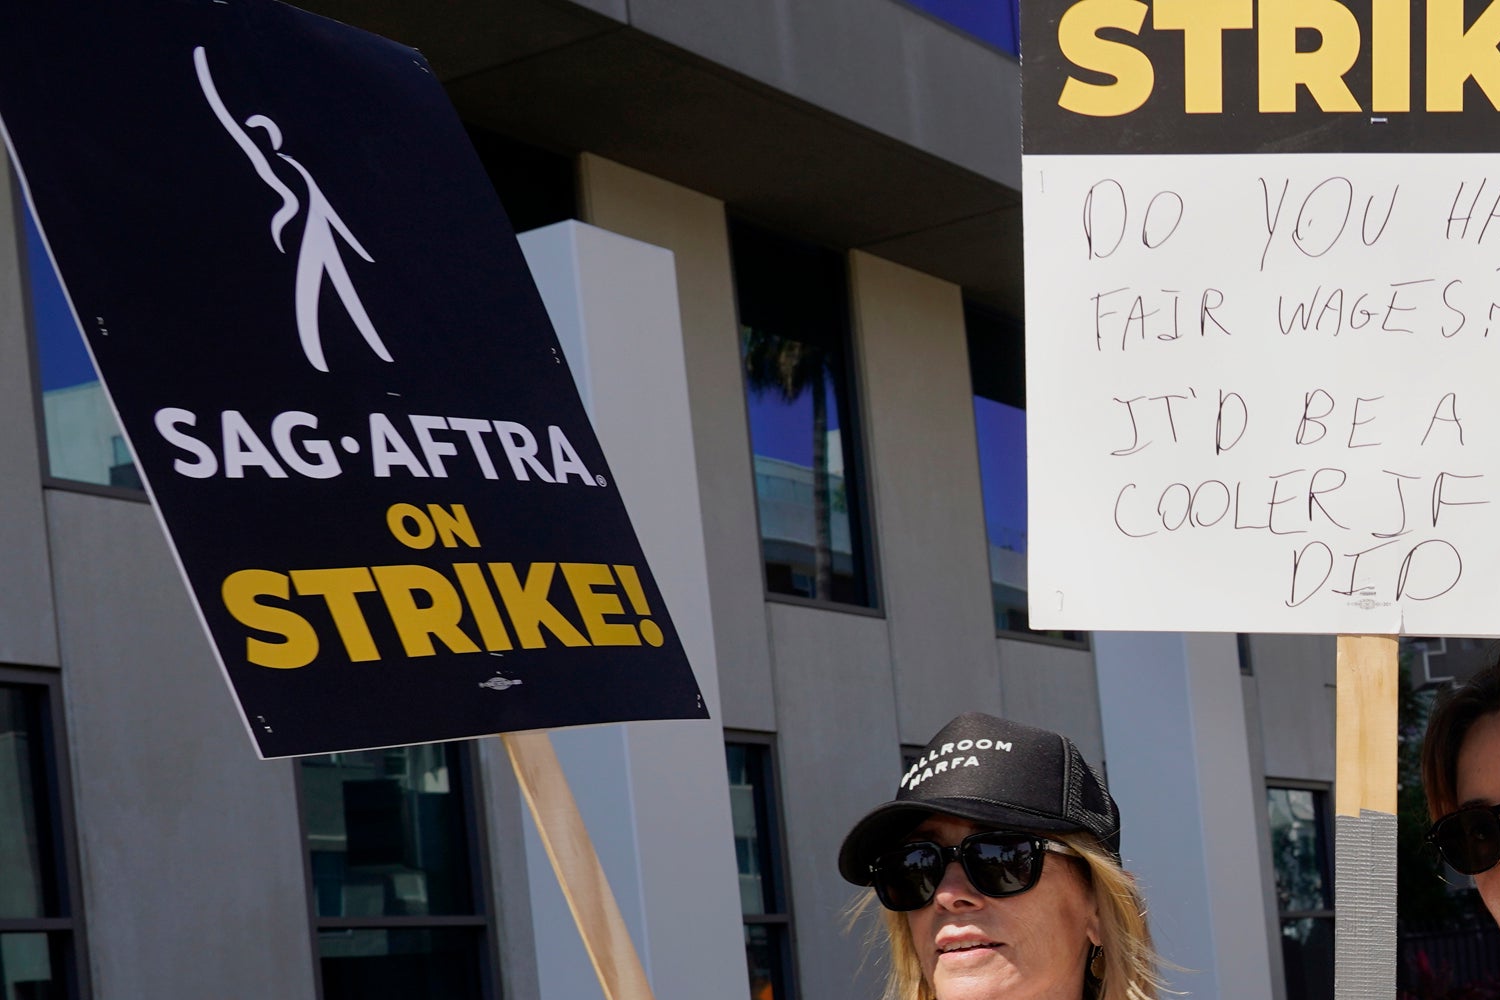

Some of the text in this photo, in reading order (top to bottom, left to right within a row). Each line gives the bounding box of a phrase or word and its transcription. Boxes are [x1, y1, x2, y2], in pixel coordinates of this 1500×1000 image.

[1083, 178, 1184, 260] DO
[1259, 176, 1400, 271] YOU
[1091, 287, 1231, 351] FAIR
[1295, 388, 1384, 449] BE
[1420, 393, 1464, 446] A
[387, 503, 481, 549] ON
[1114, 467, 1350, 538] COOLER
[1371, 469, 1489, 539] IF
[1285, 538, 1463, 608] DID
[221, 562, 664, 669] STRIKE!
